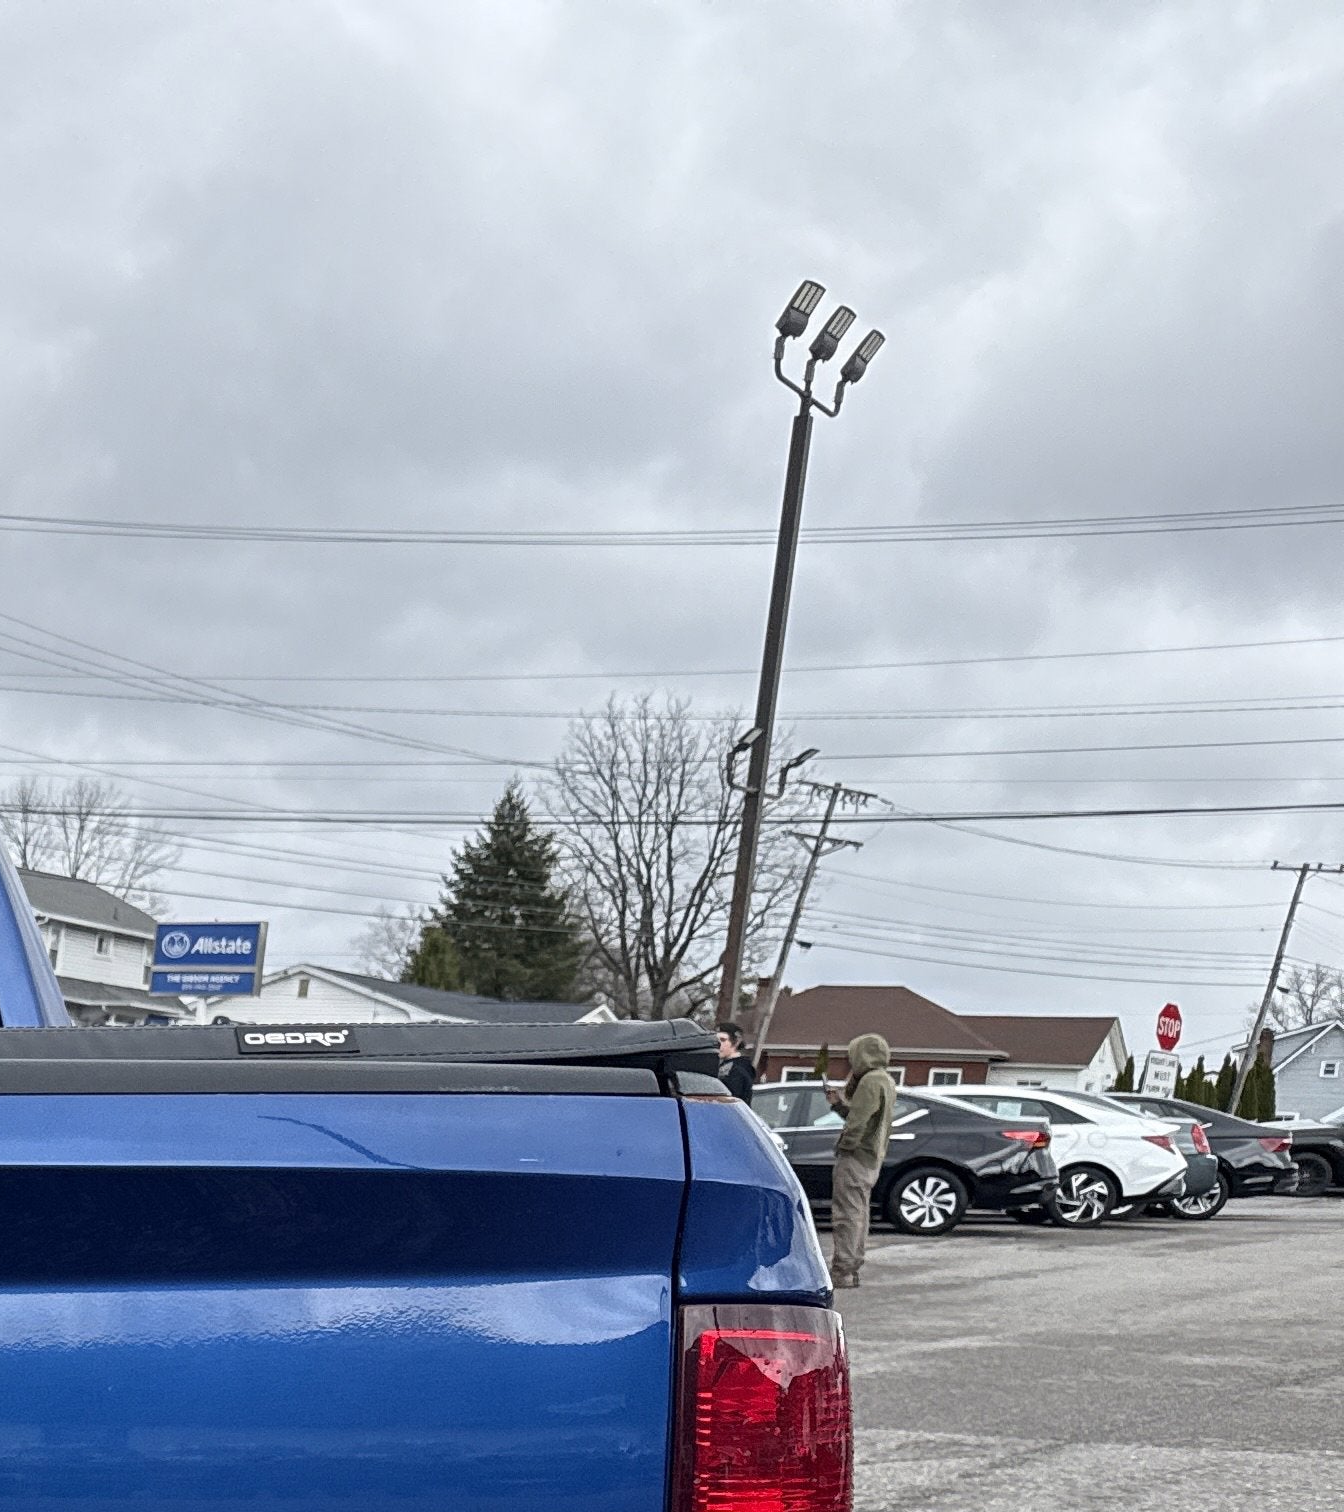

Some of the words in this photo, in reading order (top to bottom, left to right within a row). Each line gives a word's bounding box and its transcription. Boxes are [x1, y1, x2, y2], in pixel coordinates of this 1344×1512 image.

[191, 936, 252, 955] Allstate
[1158, 1016, 1180, 1038] STOP
[1154, 1071, 1170, 1082] MUST
